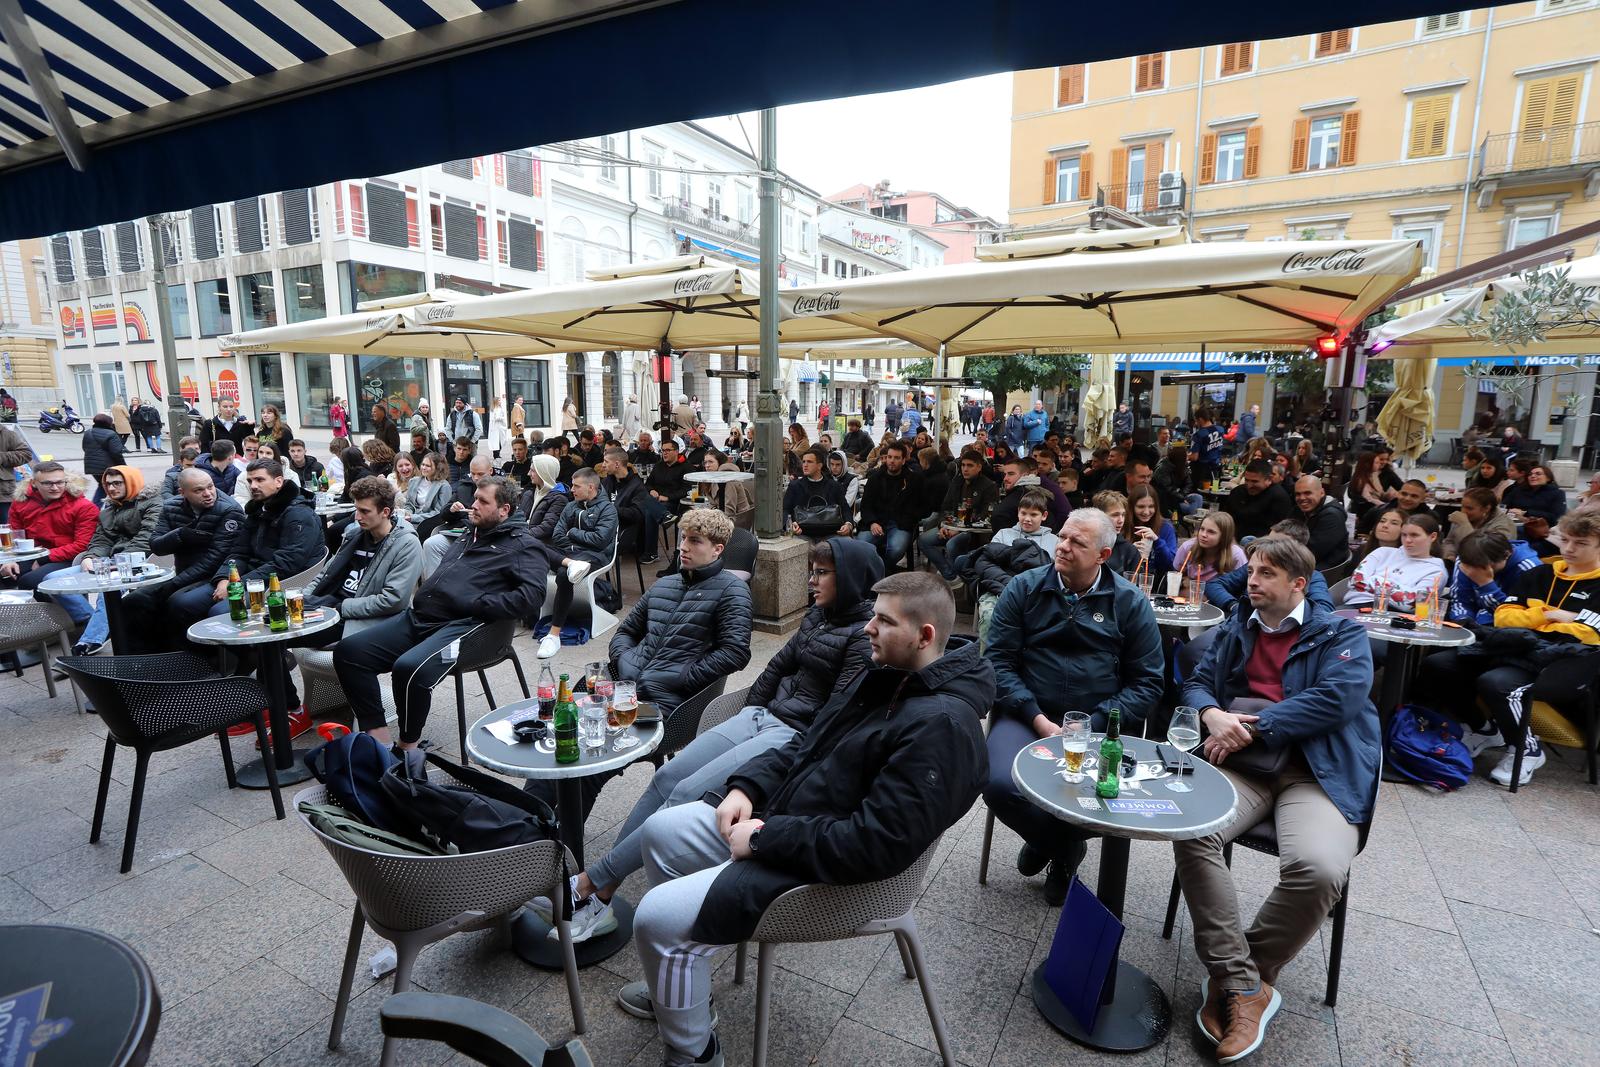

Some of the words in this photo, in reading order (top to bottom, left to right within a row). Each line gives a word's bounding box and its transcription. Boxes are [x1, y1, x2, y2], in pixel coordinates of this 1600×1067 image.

[1281, 248, 1369, 273] Coca-Cola
[673, 274, 714, 295] Coca-Cola
[793, 291, 841, 315] Coca-Cola
[218, 381, 239, 390] BURGER
[1111, 801, 1176, 810] POMMERY
